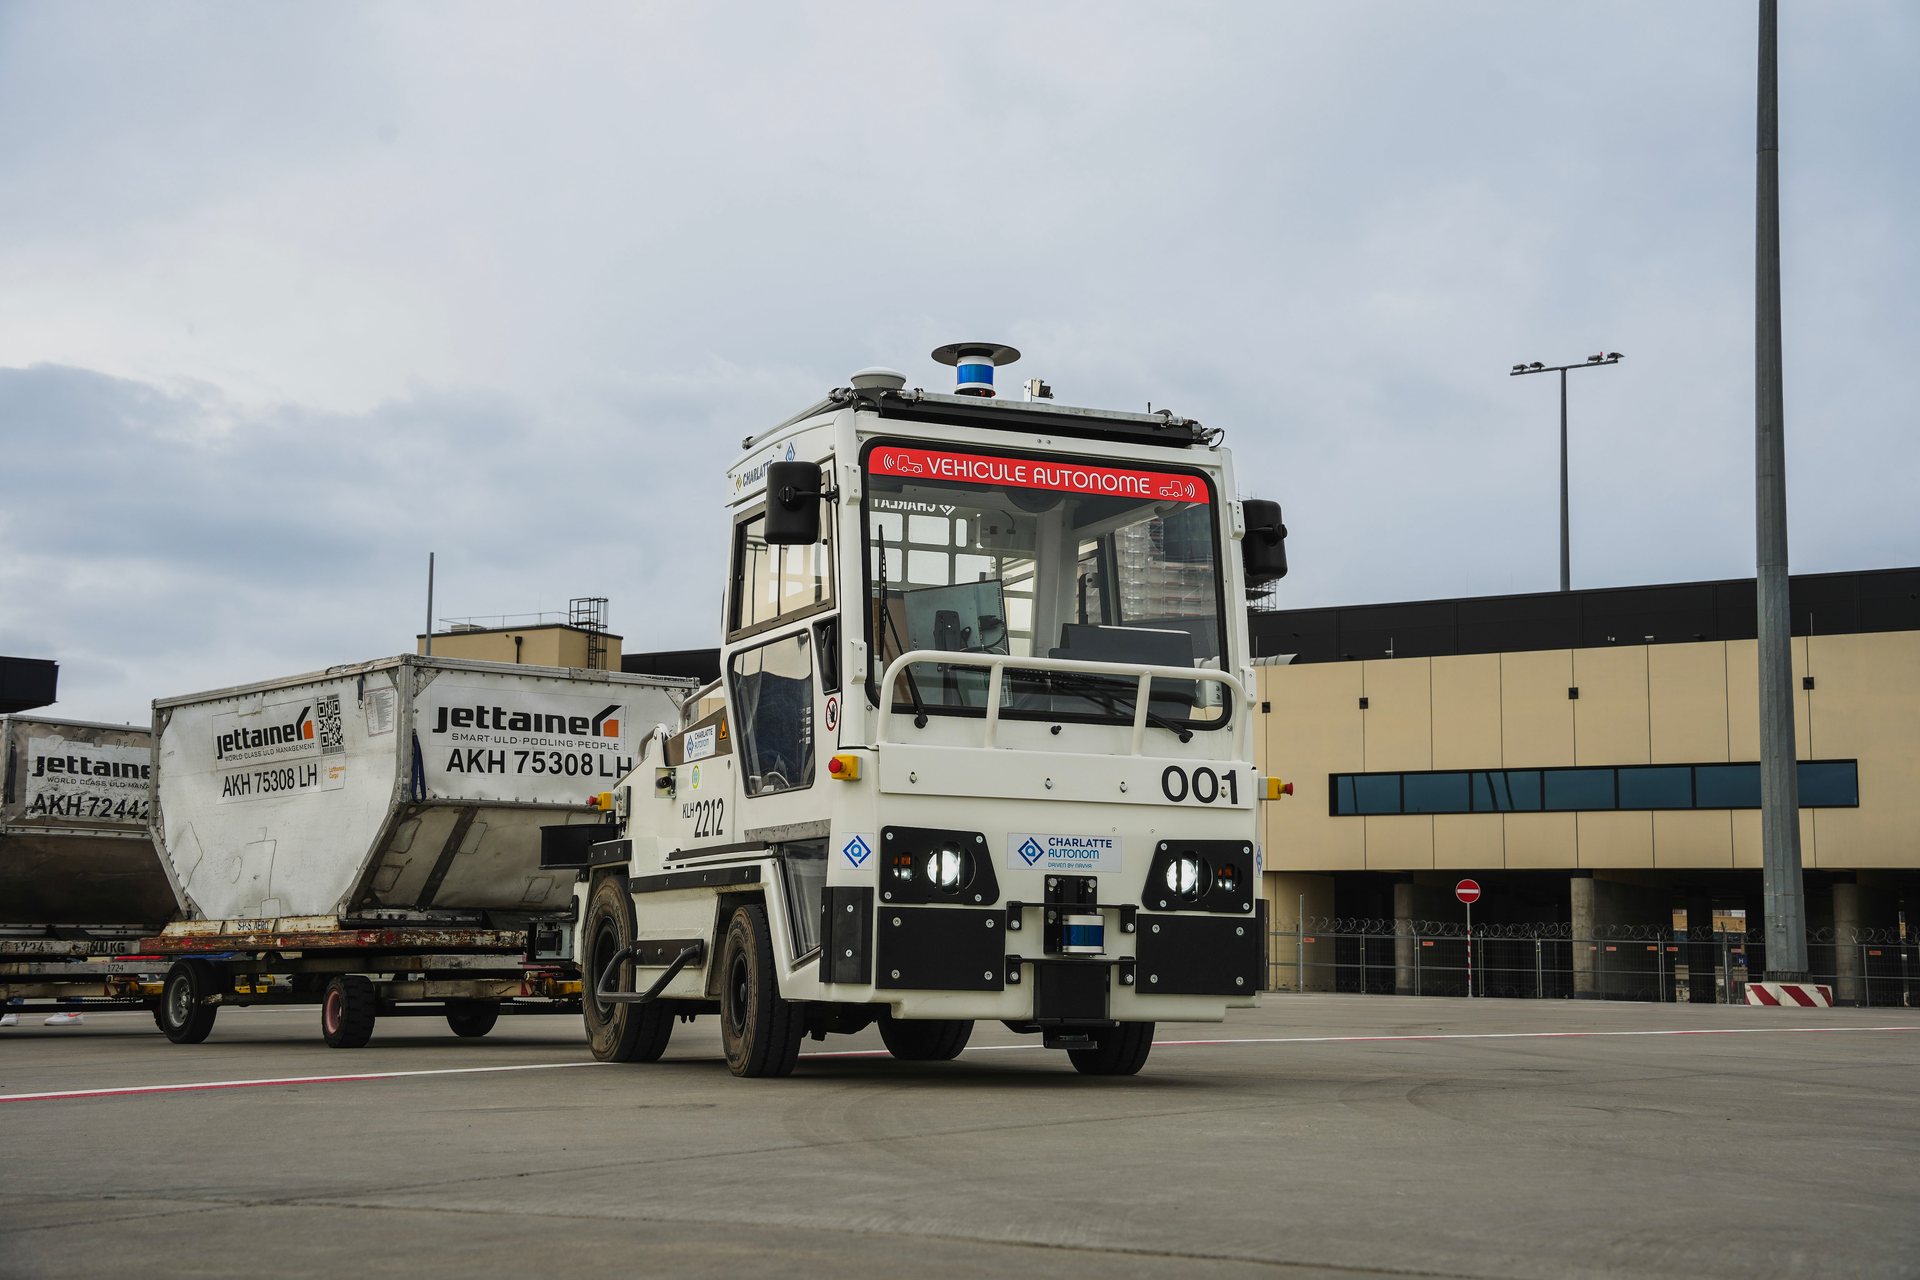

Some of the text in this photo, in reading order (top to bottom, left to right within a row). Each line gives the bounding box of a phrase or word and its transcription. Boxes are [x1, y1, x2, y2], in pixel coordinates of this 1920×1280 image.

[743, 459, 773, 487] CHARLATT
[926, 456, 1151, 494] VEHICULE AUTONOME
[432, 704, 622, 737] jettainer
[244, 751, 262, 760] CLASS
[262, 748, 275, 757] ULD
[275, 742, 315, 754] MANAGEMENT
[446, 748, 632, 779] AKH 75308 LH
[32, 755, 150, 780] jettaine
[222, 763, 317, 797] AKH 75308 LH
[46, 776, 77, 784] WORLD
[79, 779, 107, 787] CLASS
[128, 782, 149, 790] MANA
[1161, 765, 1238, 805] 001
[30, 793, 81, 817] AKH
[682, 797, 724, 838] KLH 2212
[1048, 837, 1112, 848] CHARLATTE
[1048, 848, 1099, 859] AUTONOM
[110, 942, 125, 953] KG
[107, 964, 124, 972] 1724
